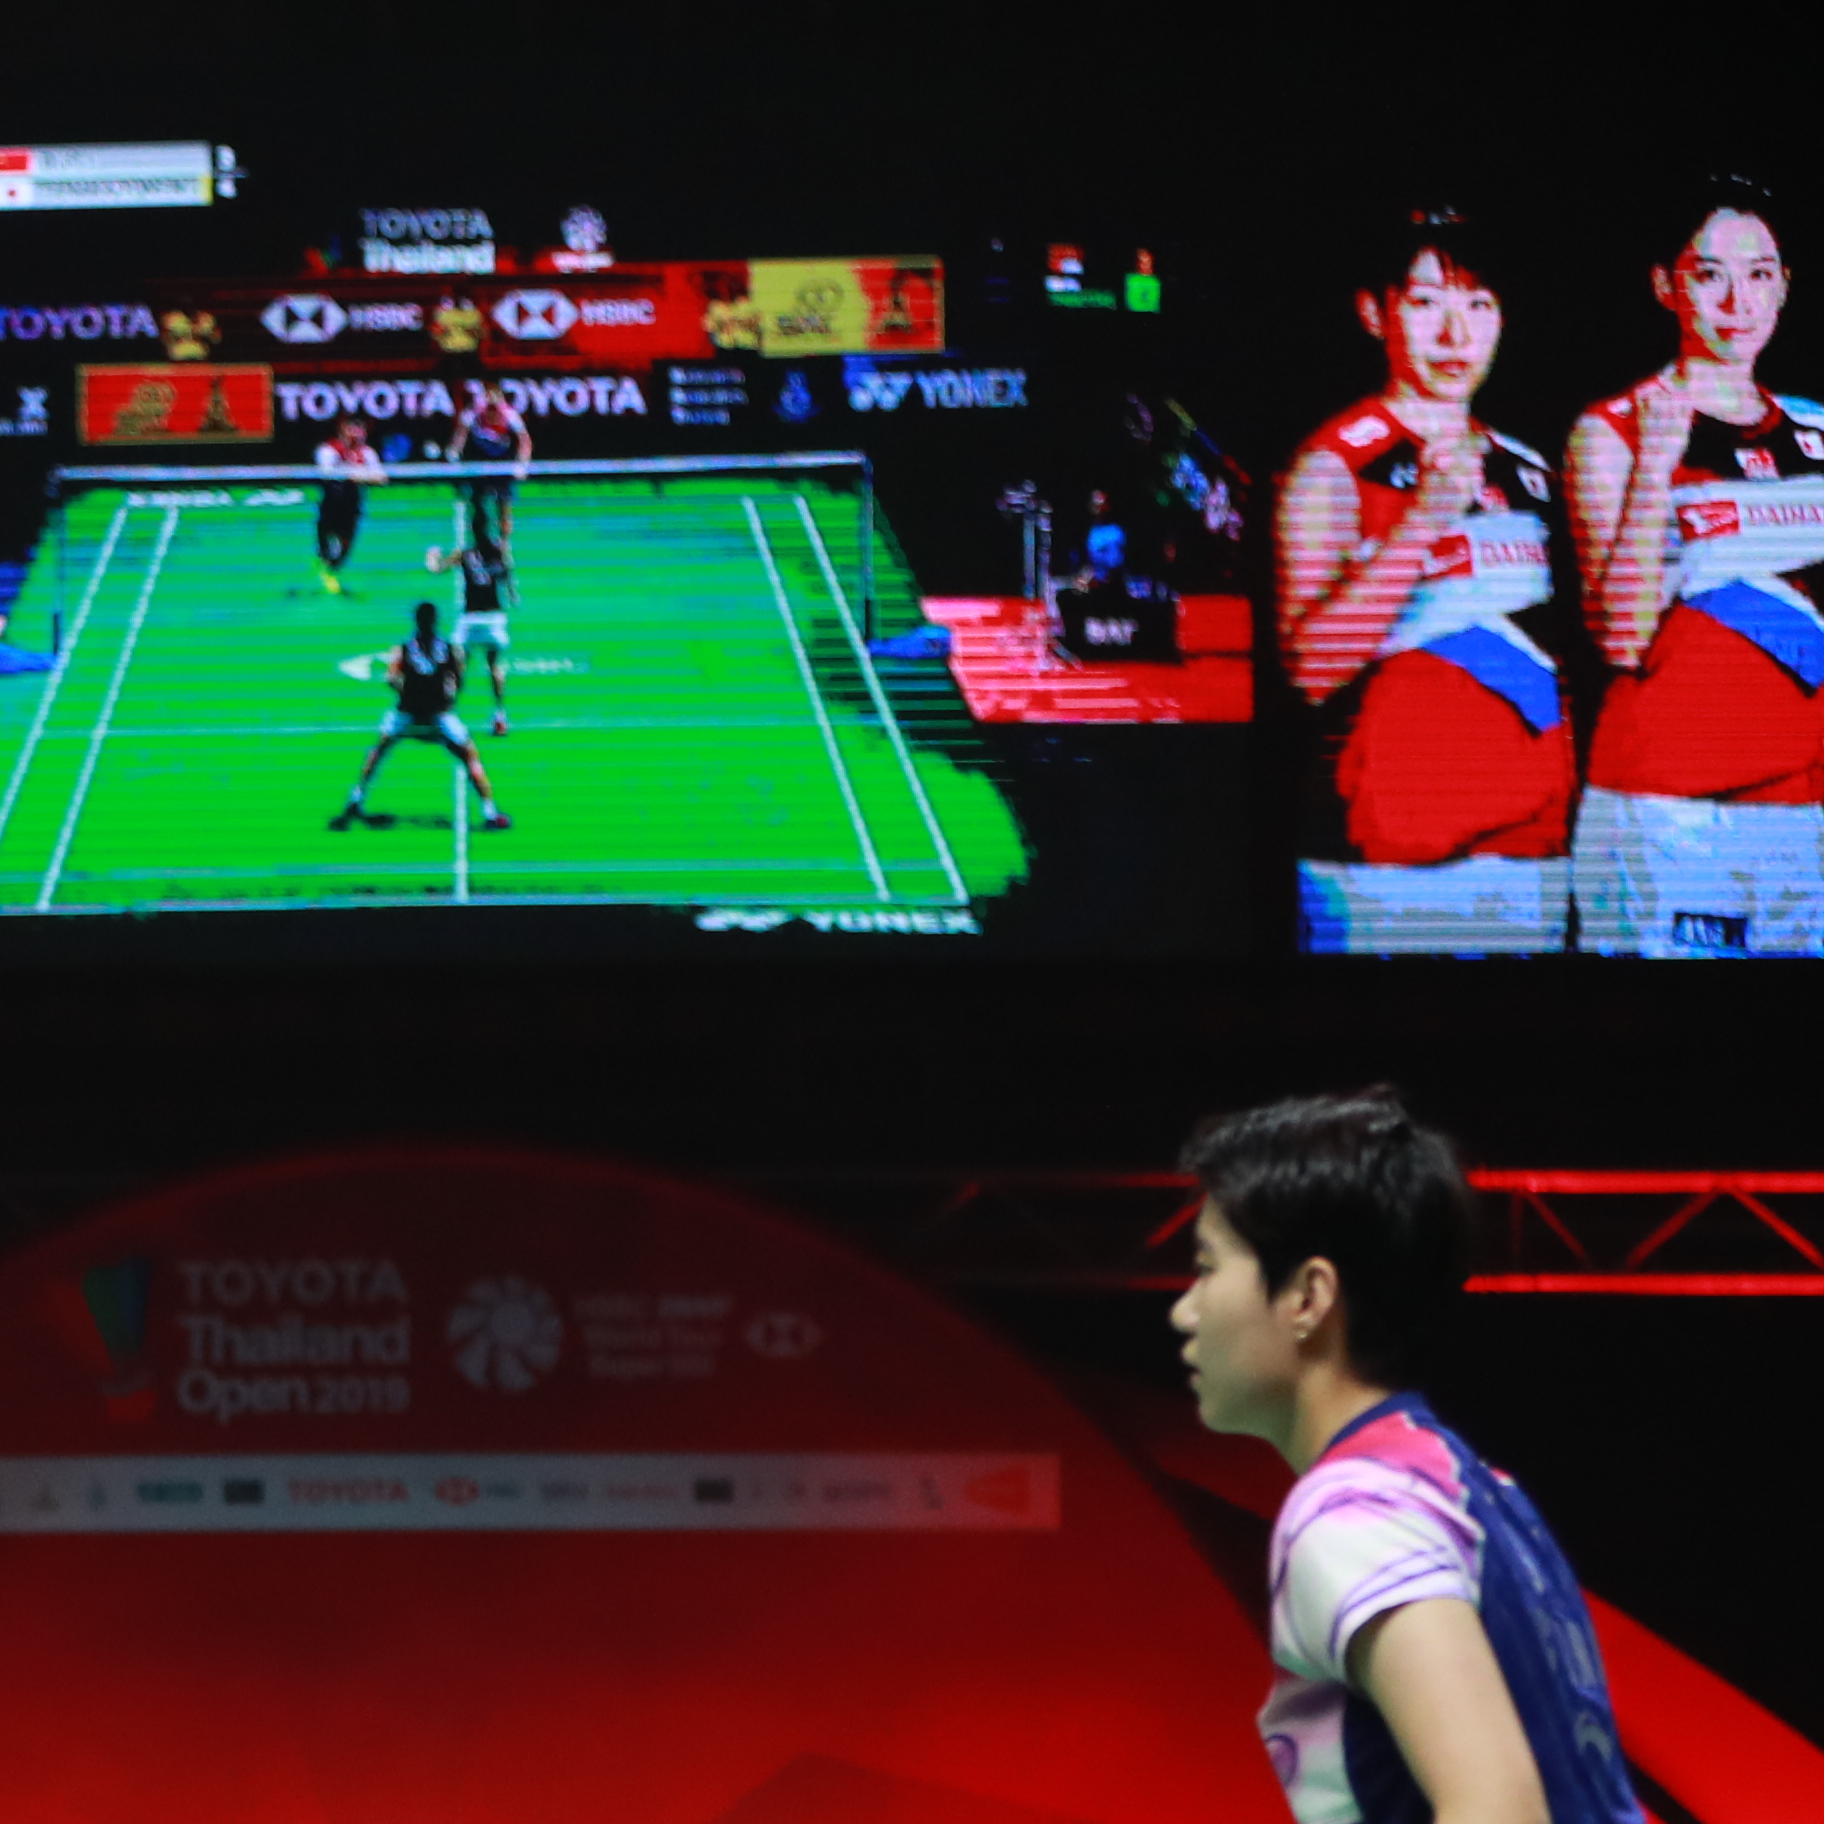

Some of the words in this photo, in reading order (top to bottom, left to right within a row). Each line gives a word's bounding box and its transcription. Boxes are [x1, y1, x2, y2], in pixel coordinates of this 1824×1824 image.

[361, 208, 494, 239] TOYOTA
[274, 378, 456, 421] TOYOTA
[915, 368, 1029, 407] YONEX
[177, 1259, 409, 1306] TOYOTA
[177, 1313, 411, 1366] Thailand
[177, 1367, 310, 1426] Open
